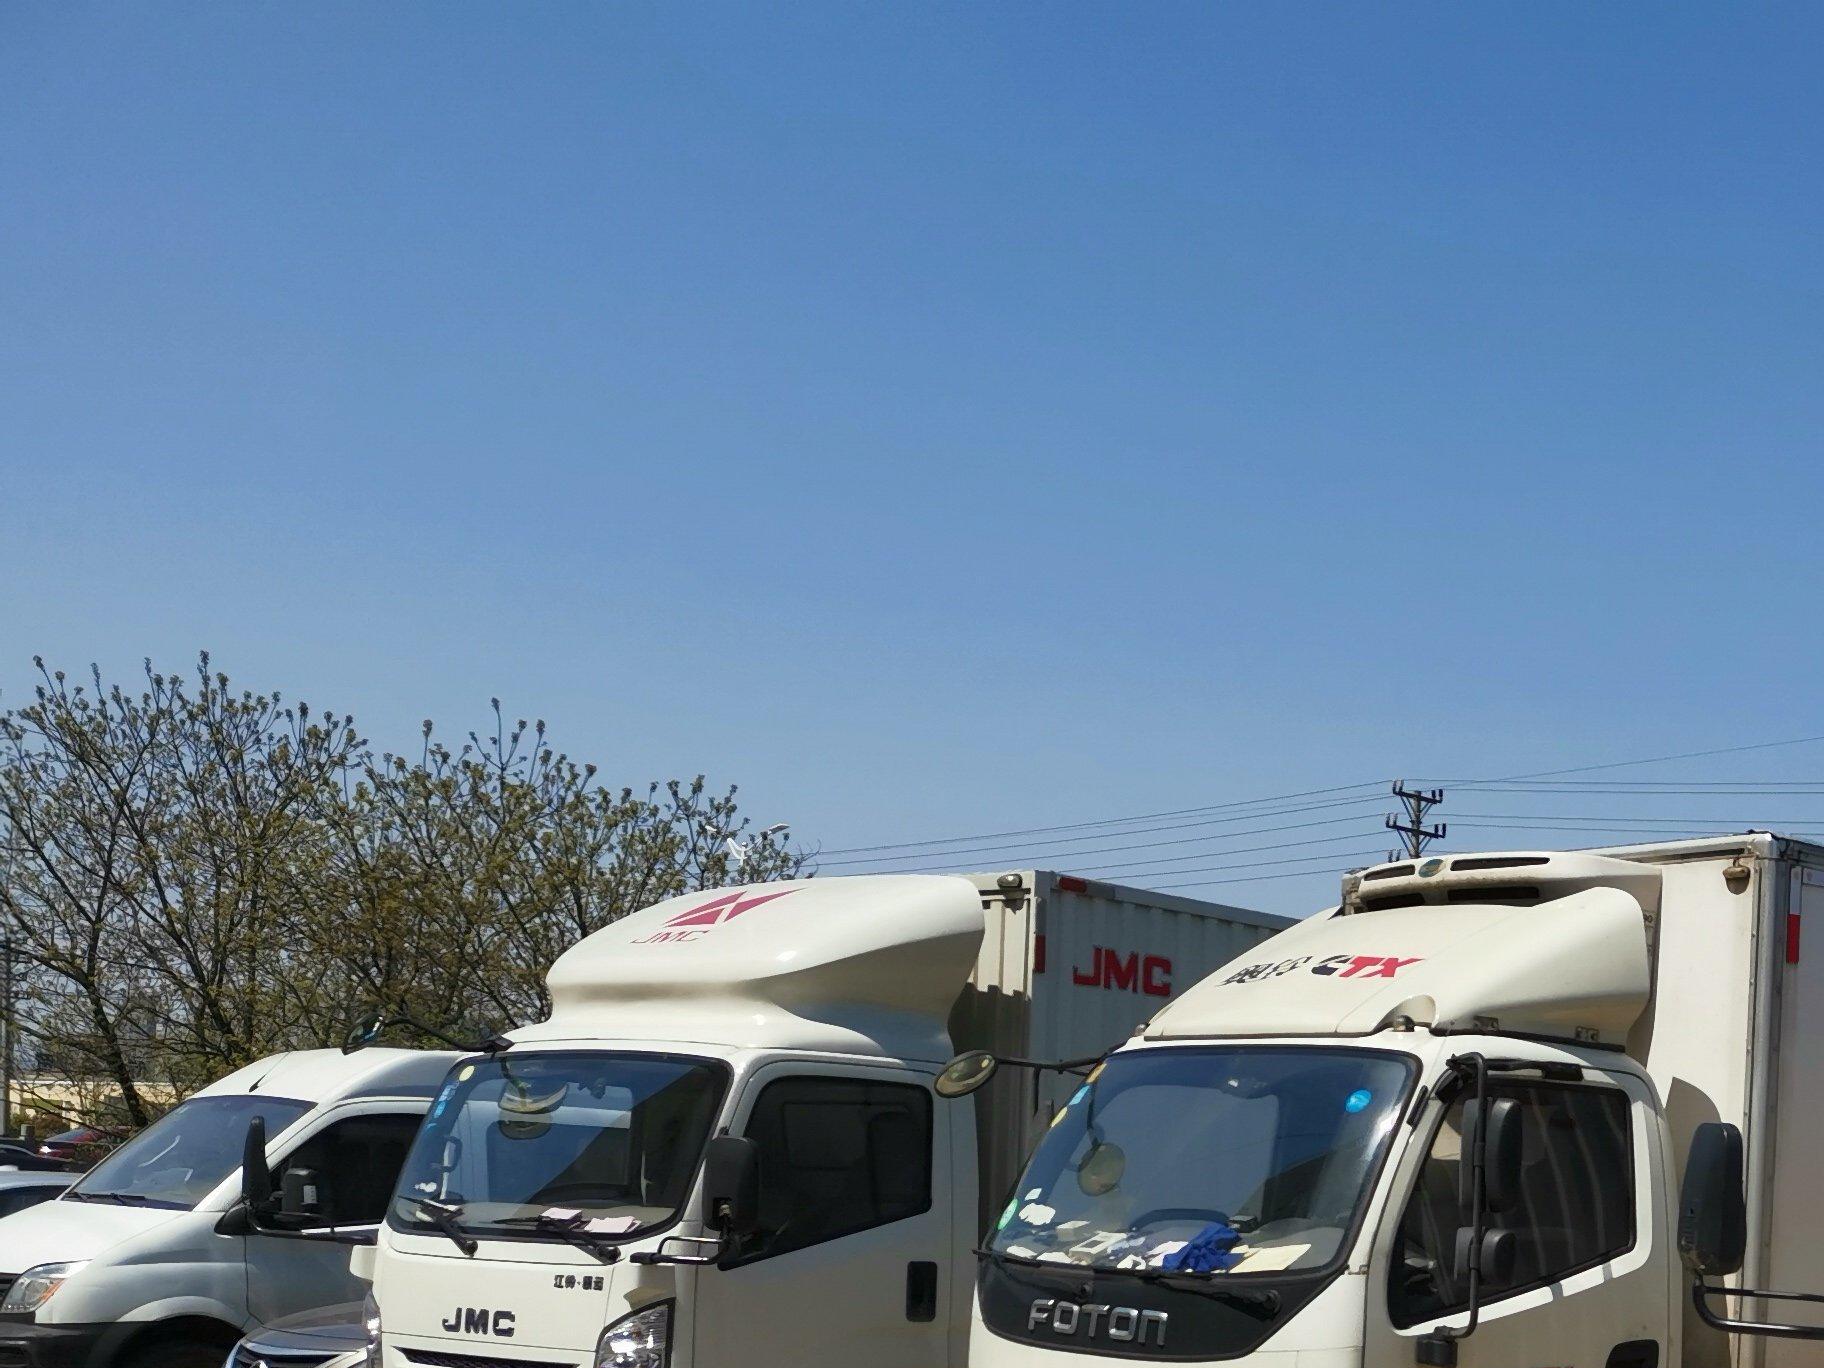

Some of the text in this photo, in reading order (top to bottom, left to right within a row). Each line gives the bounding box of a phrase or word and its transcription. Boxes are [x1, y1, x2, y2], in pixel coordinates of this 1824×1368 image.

[630, 929, 710, 944] JMC
[1072, 944, 1172, 997] JMC
[442, 1307, 516, 1337] JMC
[1027, 1299, 1169, 1347] FOTON
